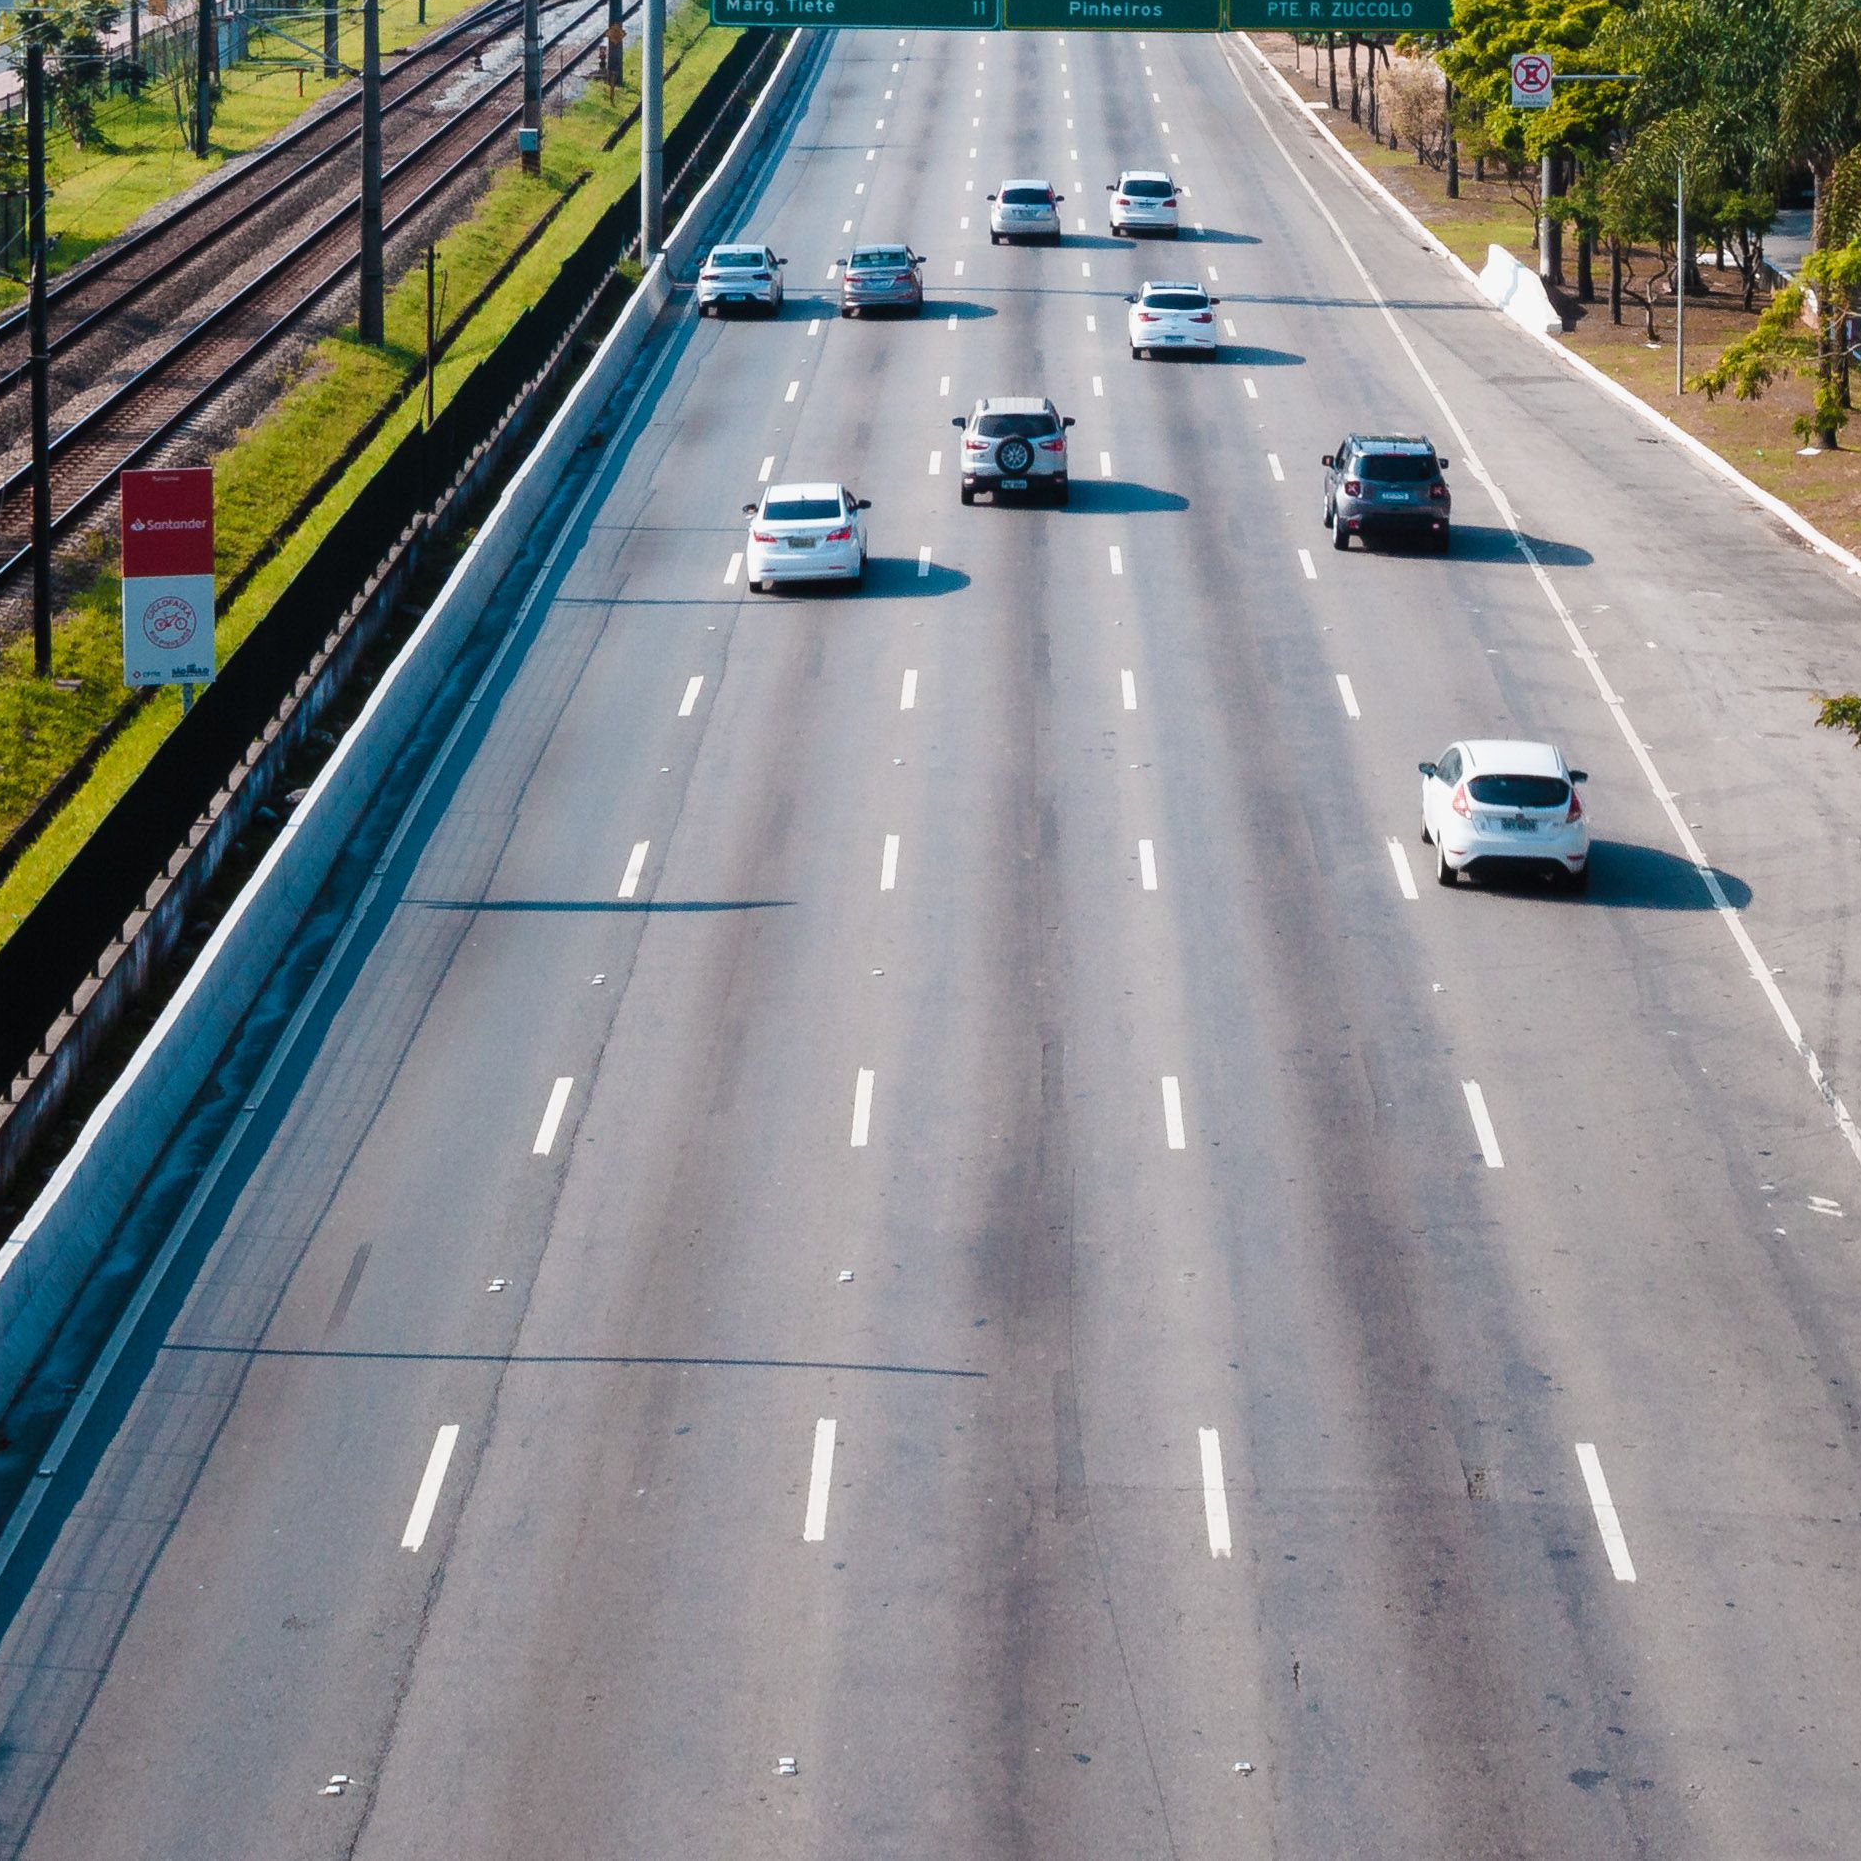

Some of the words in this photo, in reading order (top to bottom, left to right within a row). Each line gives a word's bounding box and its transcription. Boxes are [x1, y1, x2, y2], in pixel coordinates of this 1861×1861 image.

[972, 0, 986, 16] 11
[1069, 1, 1163, 17] Pinheiros
[1267, 1, 1302, 18] PTE.
[1309, 1, 1325, 17] R.
[1331, 2, 1413, 18] ZUCCOLO
[147, 518, 207, 530] Santander
